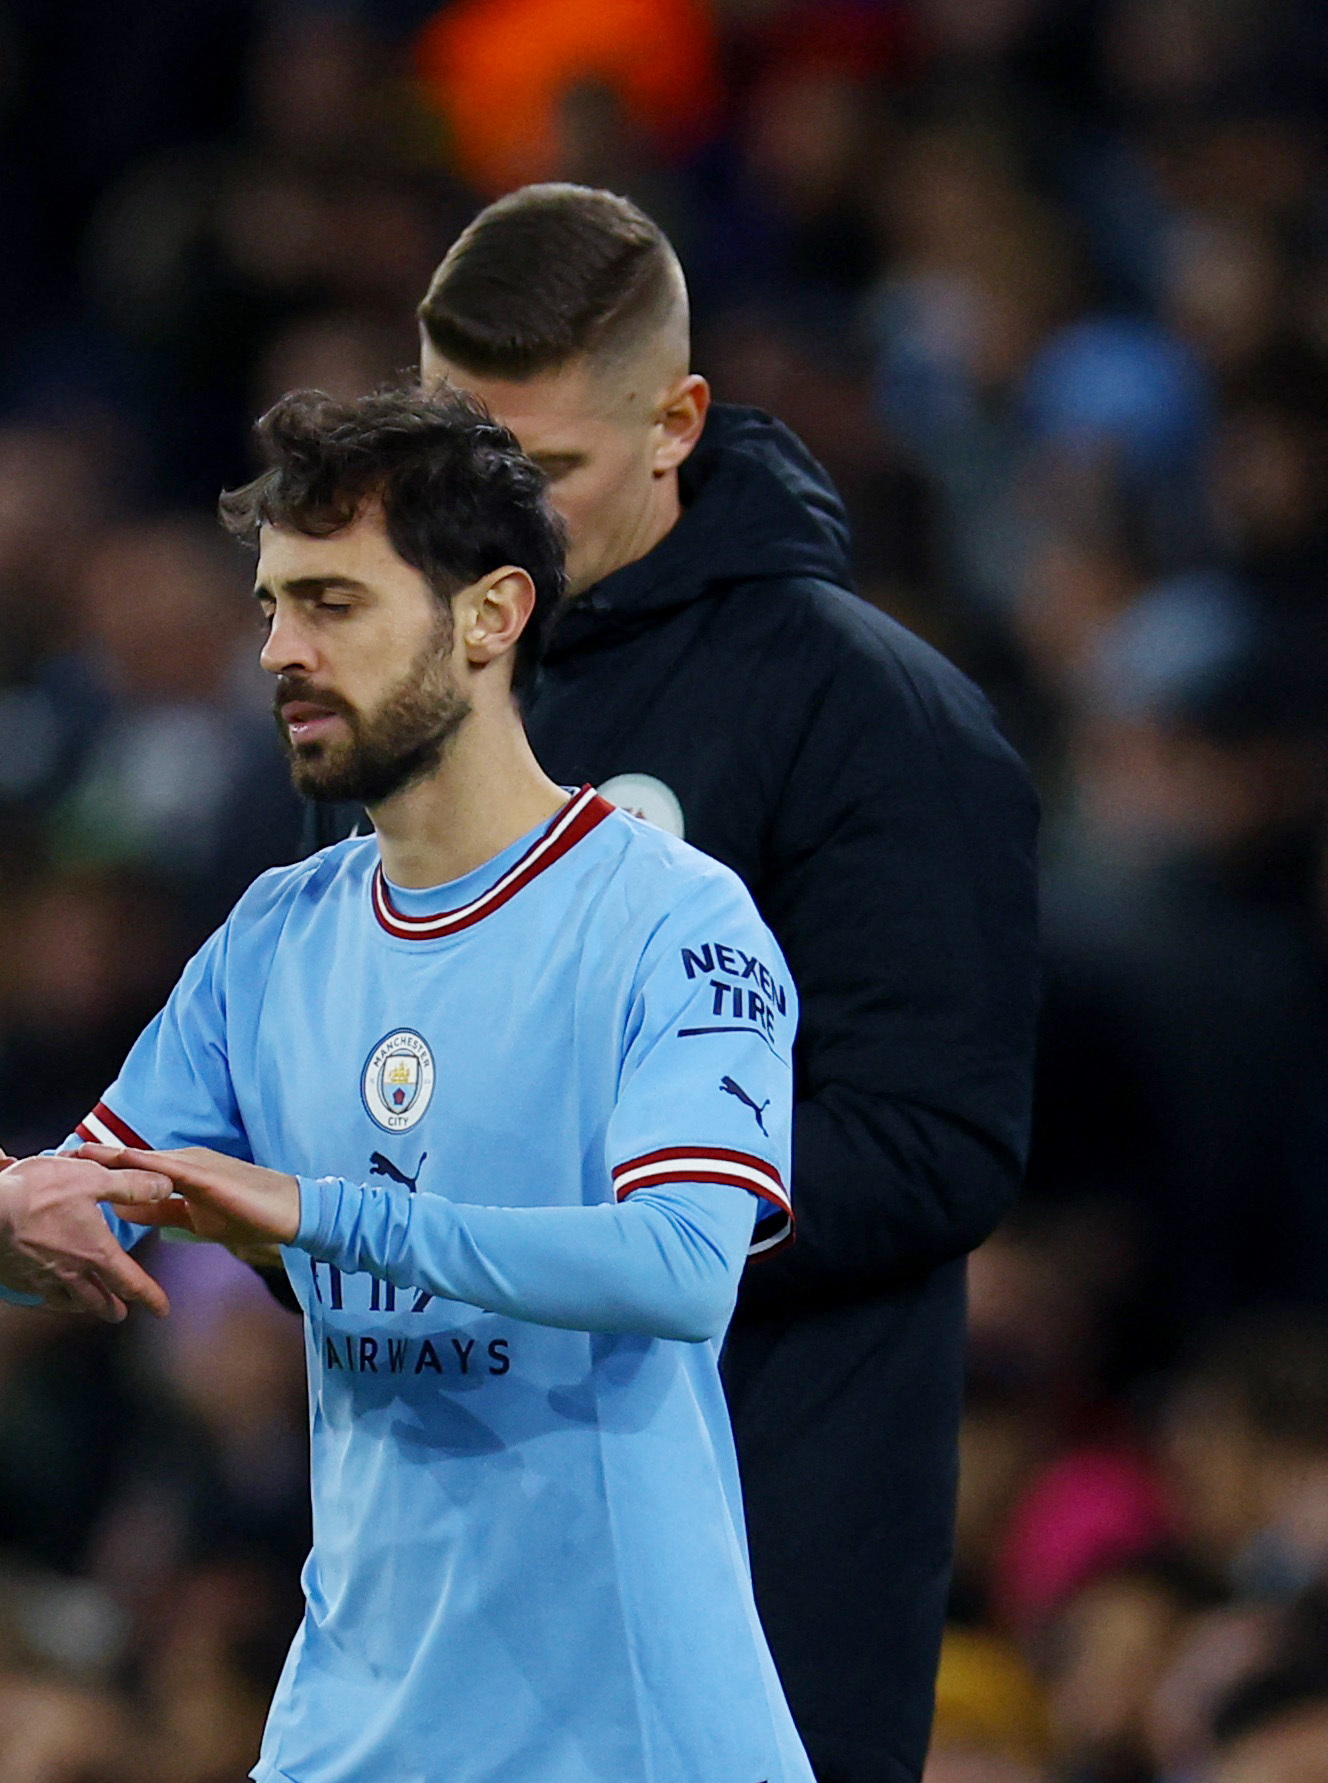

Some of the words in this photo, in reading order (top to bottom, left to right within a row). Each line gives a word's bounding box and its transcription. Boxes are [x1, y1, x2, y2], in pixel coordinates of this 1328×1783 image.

[681, 942, 786, 1017] NEXEN
[709, 978, 775, 1045] TIRE
[373, 1035, 430, 1068] MANCHESTER
[388, 1116, 409, 1127] CITY
[325, 1336, 510, 1376] AIRWAYS
